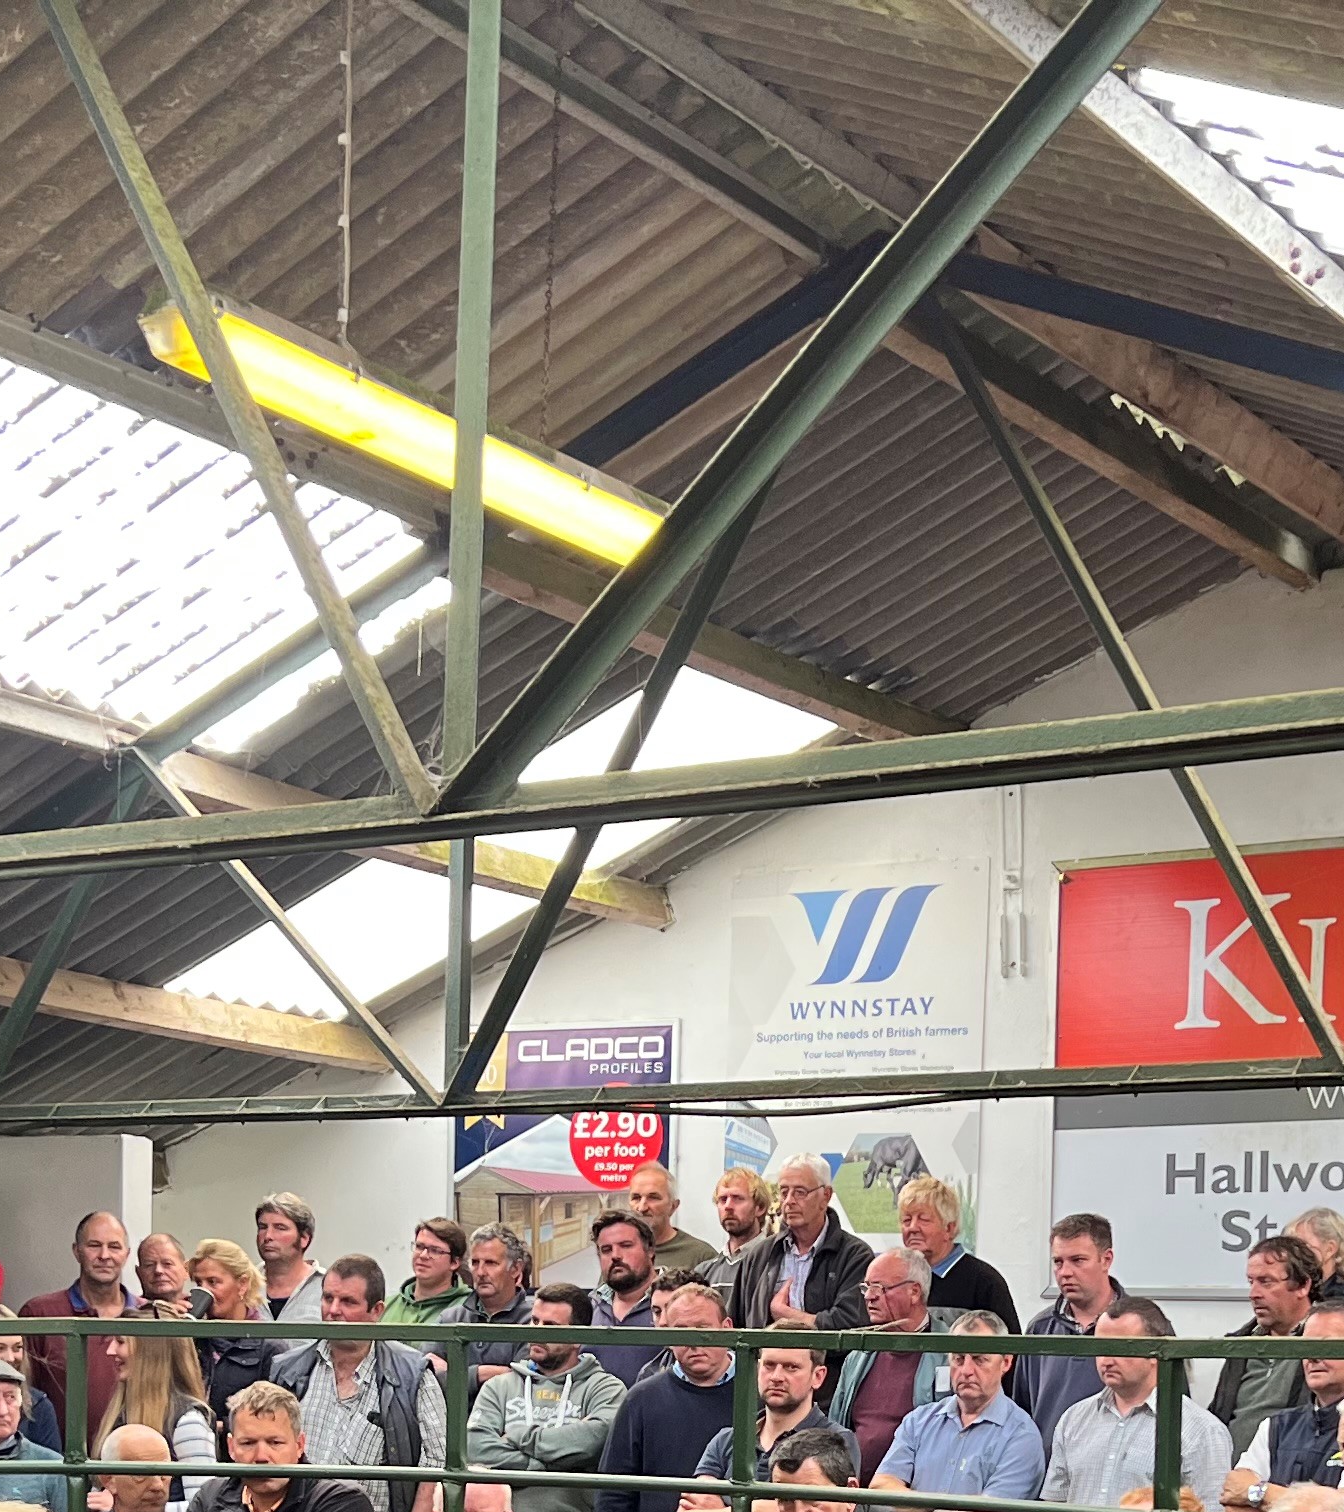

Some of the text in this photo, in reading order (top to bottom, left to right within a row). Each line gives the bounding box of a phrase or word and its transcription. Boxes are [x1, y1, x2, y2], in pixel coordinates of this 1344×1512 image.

[789, 996, 935, 1021] WYNNSTAY
[756, 1025, 969, 1045] Supporting the needs of British farmers
[517, 1035, 665, 1063] CLADCO
[803, 1048, 917, 1060] Your local Wynnstay Stores
[589, 1061, 664, 1075] PROFILES
[573, 1112, 659, 1139] £2.90
[584, 1143, 646, 1160] per foot
[594, 1163, 635, 1173] £9.50 per
[600, 1174, 628, 1183] metre
